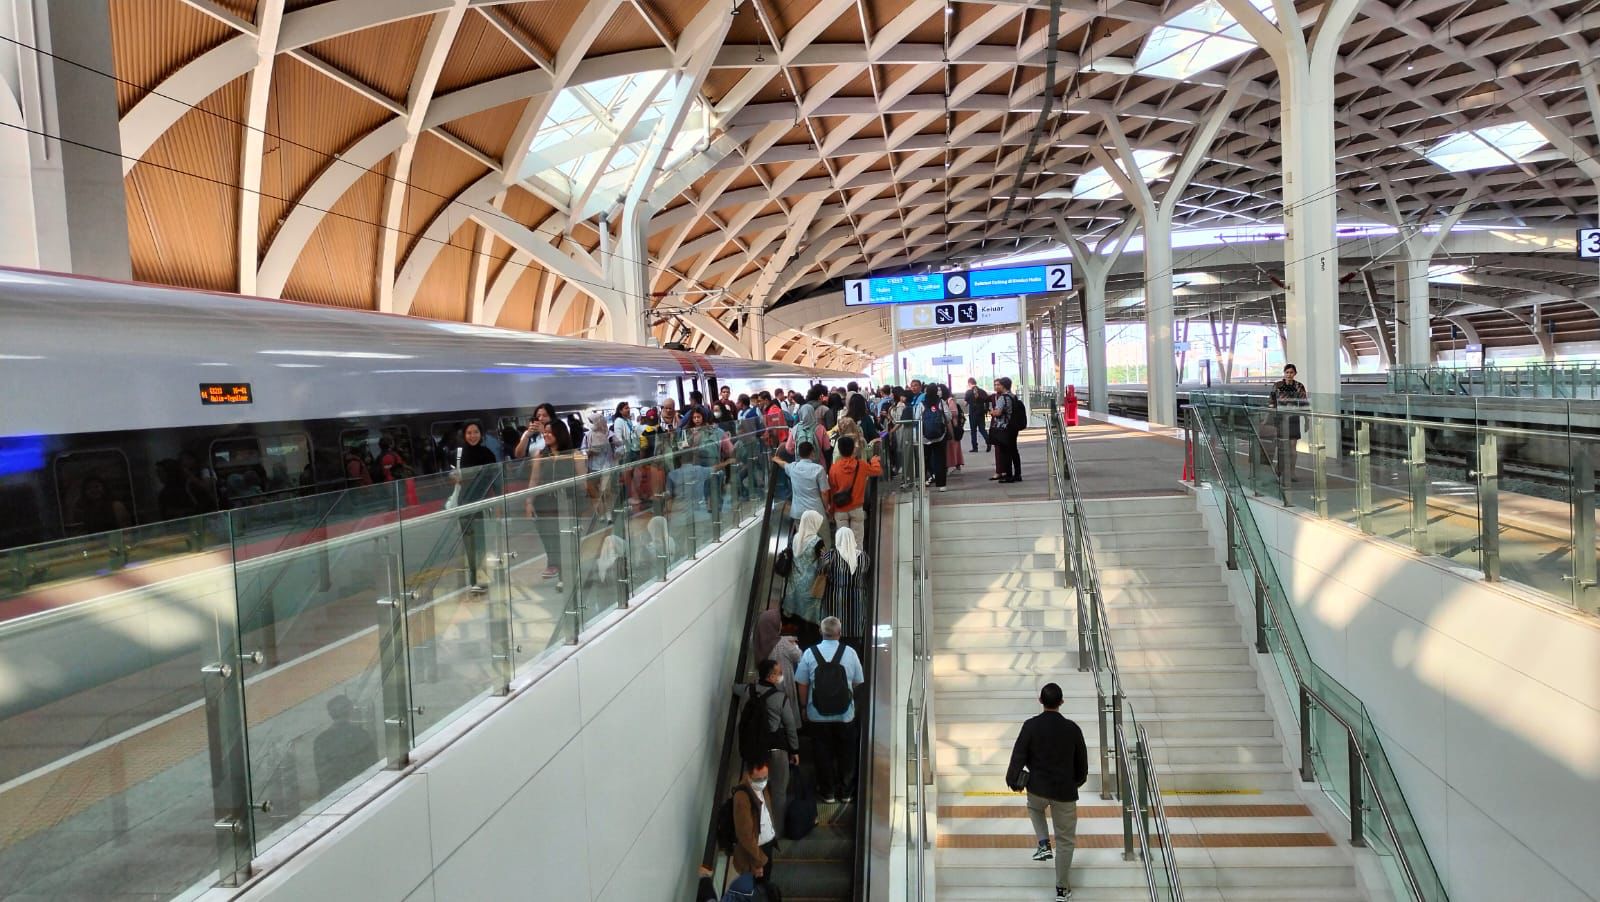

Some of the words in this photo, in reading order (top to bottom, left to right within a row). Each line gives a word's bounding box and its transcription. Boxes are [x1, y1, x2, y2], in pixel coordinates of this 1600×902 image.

[1588, 232, 1600, 253] 3
[1051, 268, 1066, 289] 2
[852, 282, 863, 302] 1
